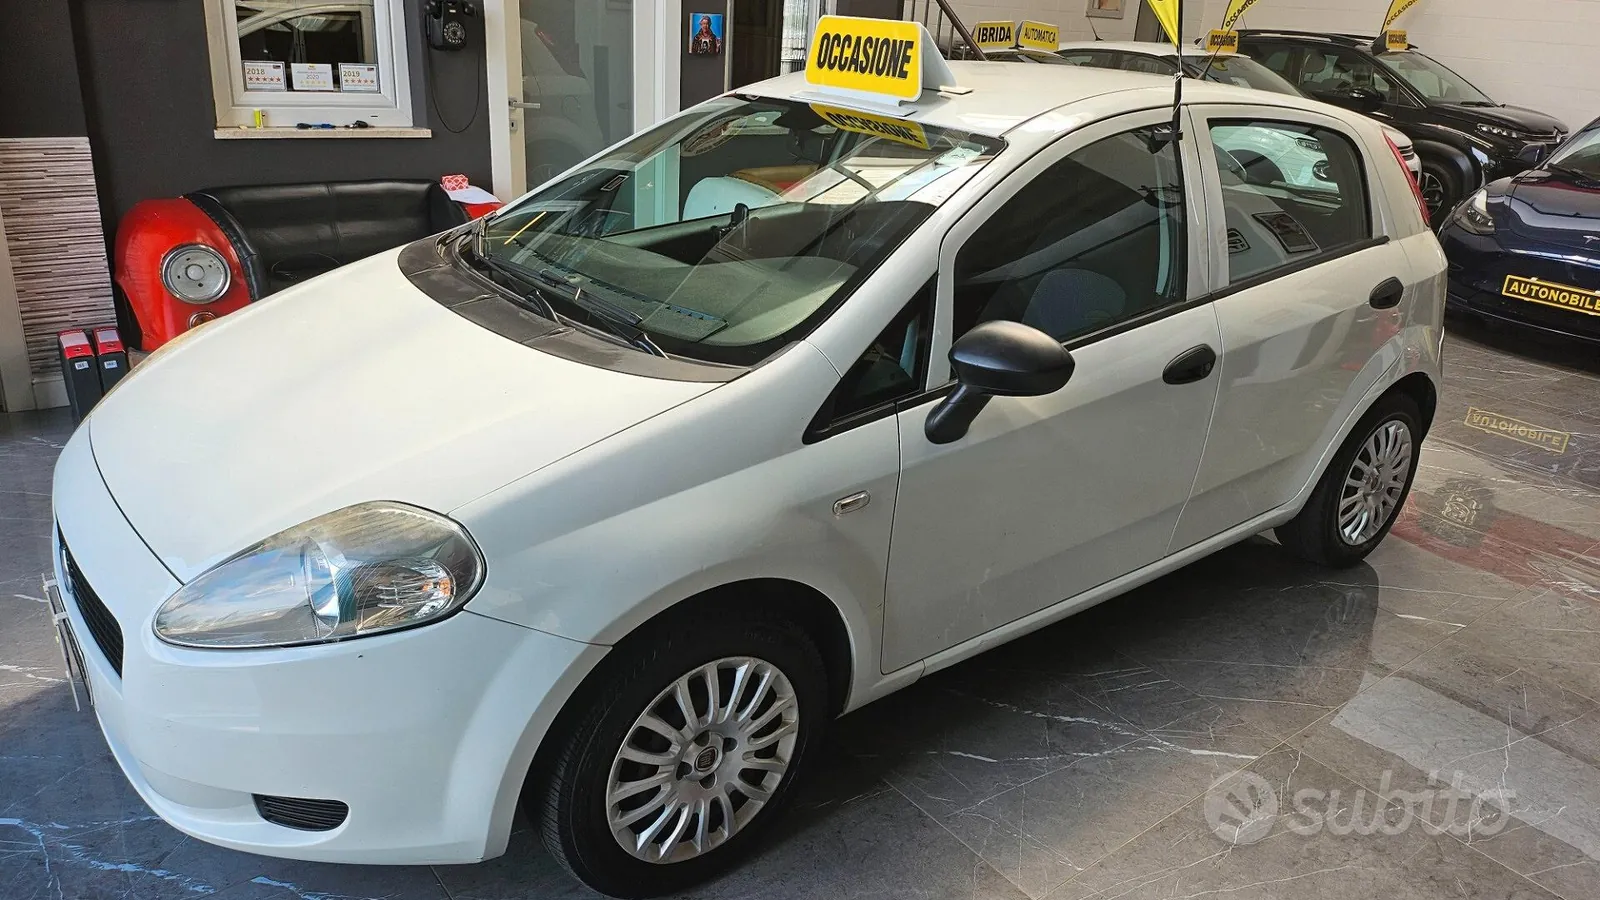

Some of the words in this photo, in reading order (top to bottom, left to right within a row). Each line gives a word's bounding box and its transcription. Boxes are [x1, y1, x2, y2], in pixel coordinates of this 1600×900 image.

[1225, 0, 1258, 27] OCCASIO
[977, 26, 1011, 43] IBRIDA
[1024, 27, 1056, 44] AUTOMATICA
[817, 32, 914, 79] OCCASIONE
